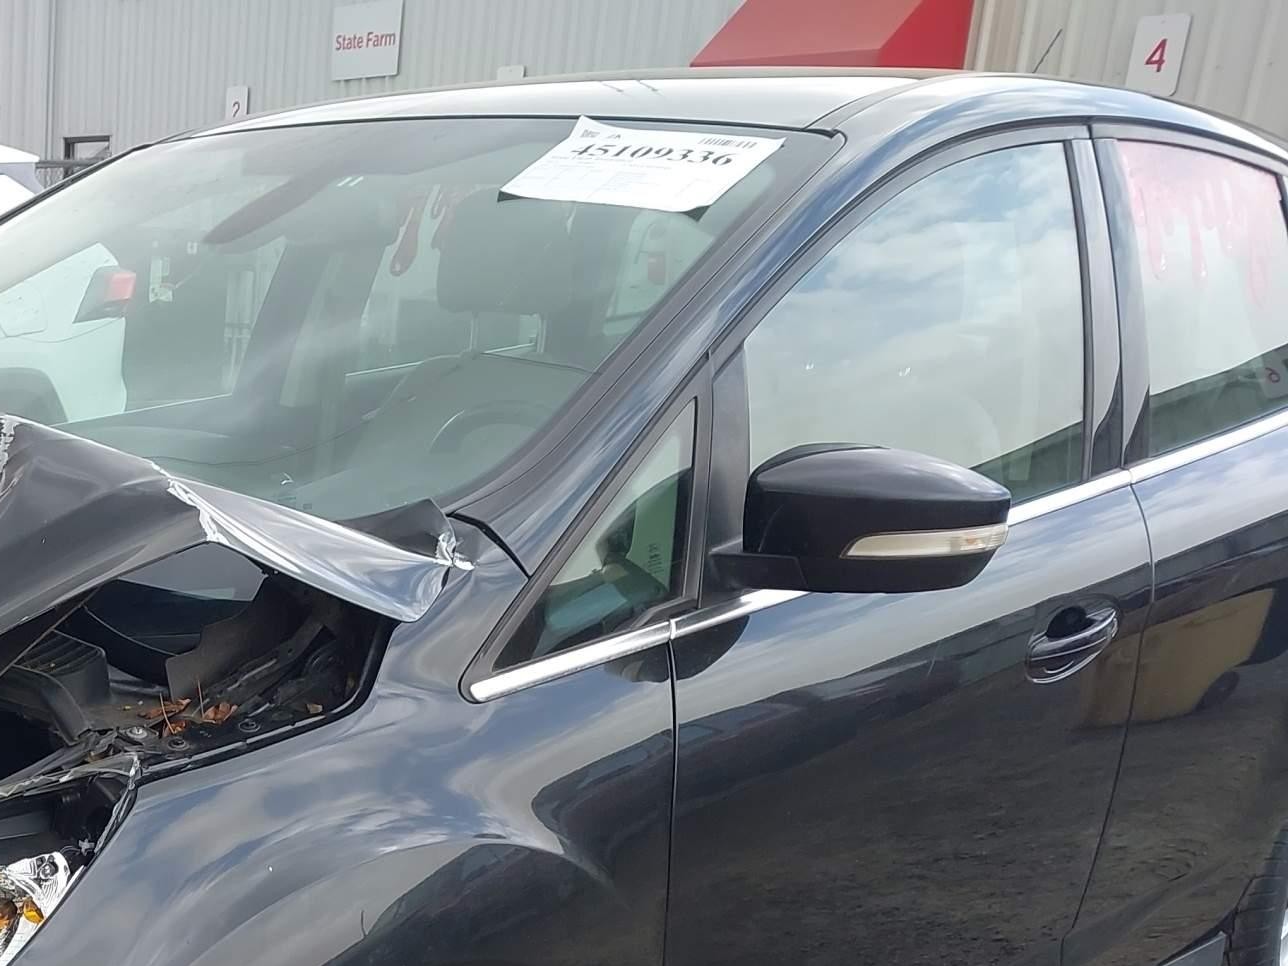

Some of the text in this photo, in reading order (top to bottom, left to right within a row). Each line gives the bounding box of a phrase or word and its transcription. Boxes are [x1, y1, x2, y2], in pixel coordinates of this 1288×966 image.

[335, 31, 396, 51] State Farm
[1144, 37, 1169, 73] 4
[571, 144, 736, 167] 45109336
